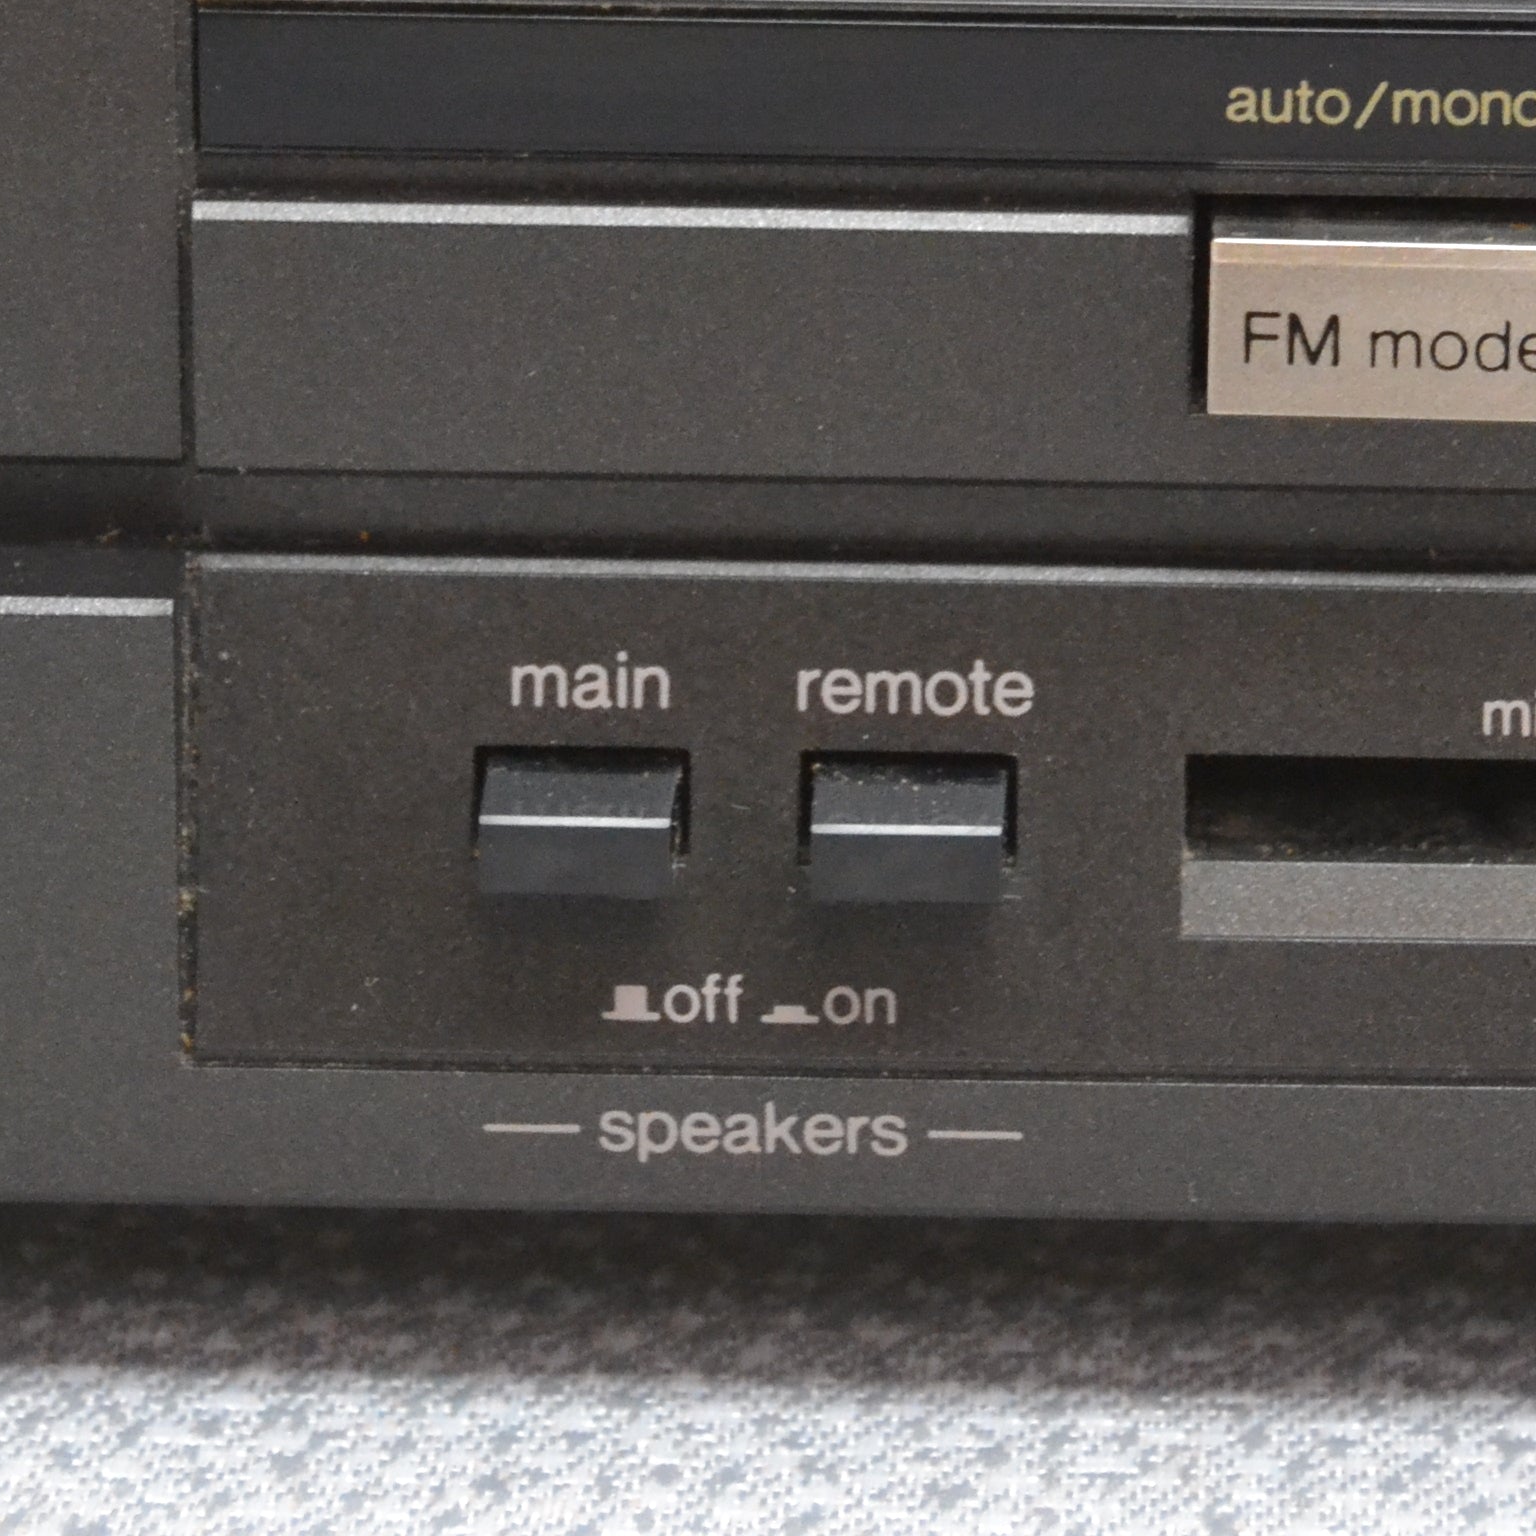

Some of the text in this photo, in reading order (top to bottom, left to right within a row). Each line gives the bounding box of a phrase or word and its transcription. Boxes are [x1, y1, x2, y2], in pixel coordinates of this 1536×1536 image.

[1242, 309, 1341, 368] FM
[509, 649, 671, 711] main
[796, 658, 1036, 718] remote
[662, 971, 898, 1027] off on
[597, 1100, 909, 1164] speakers
